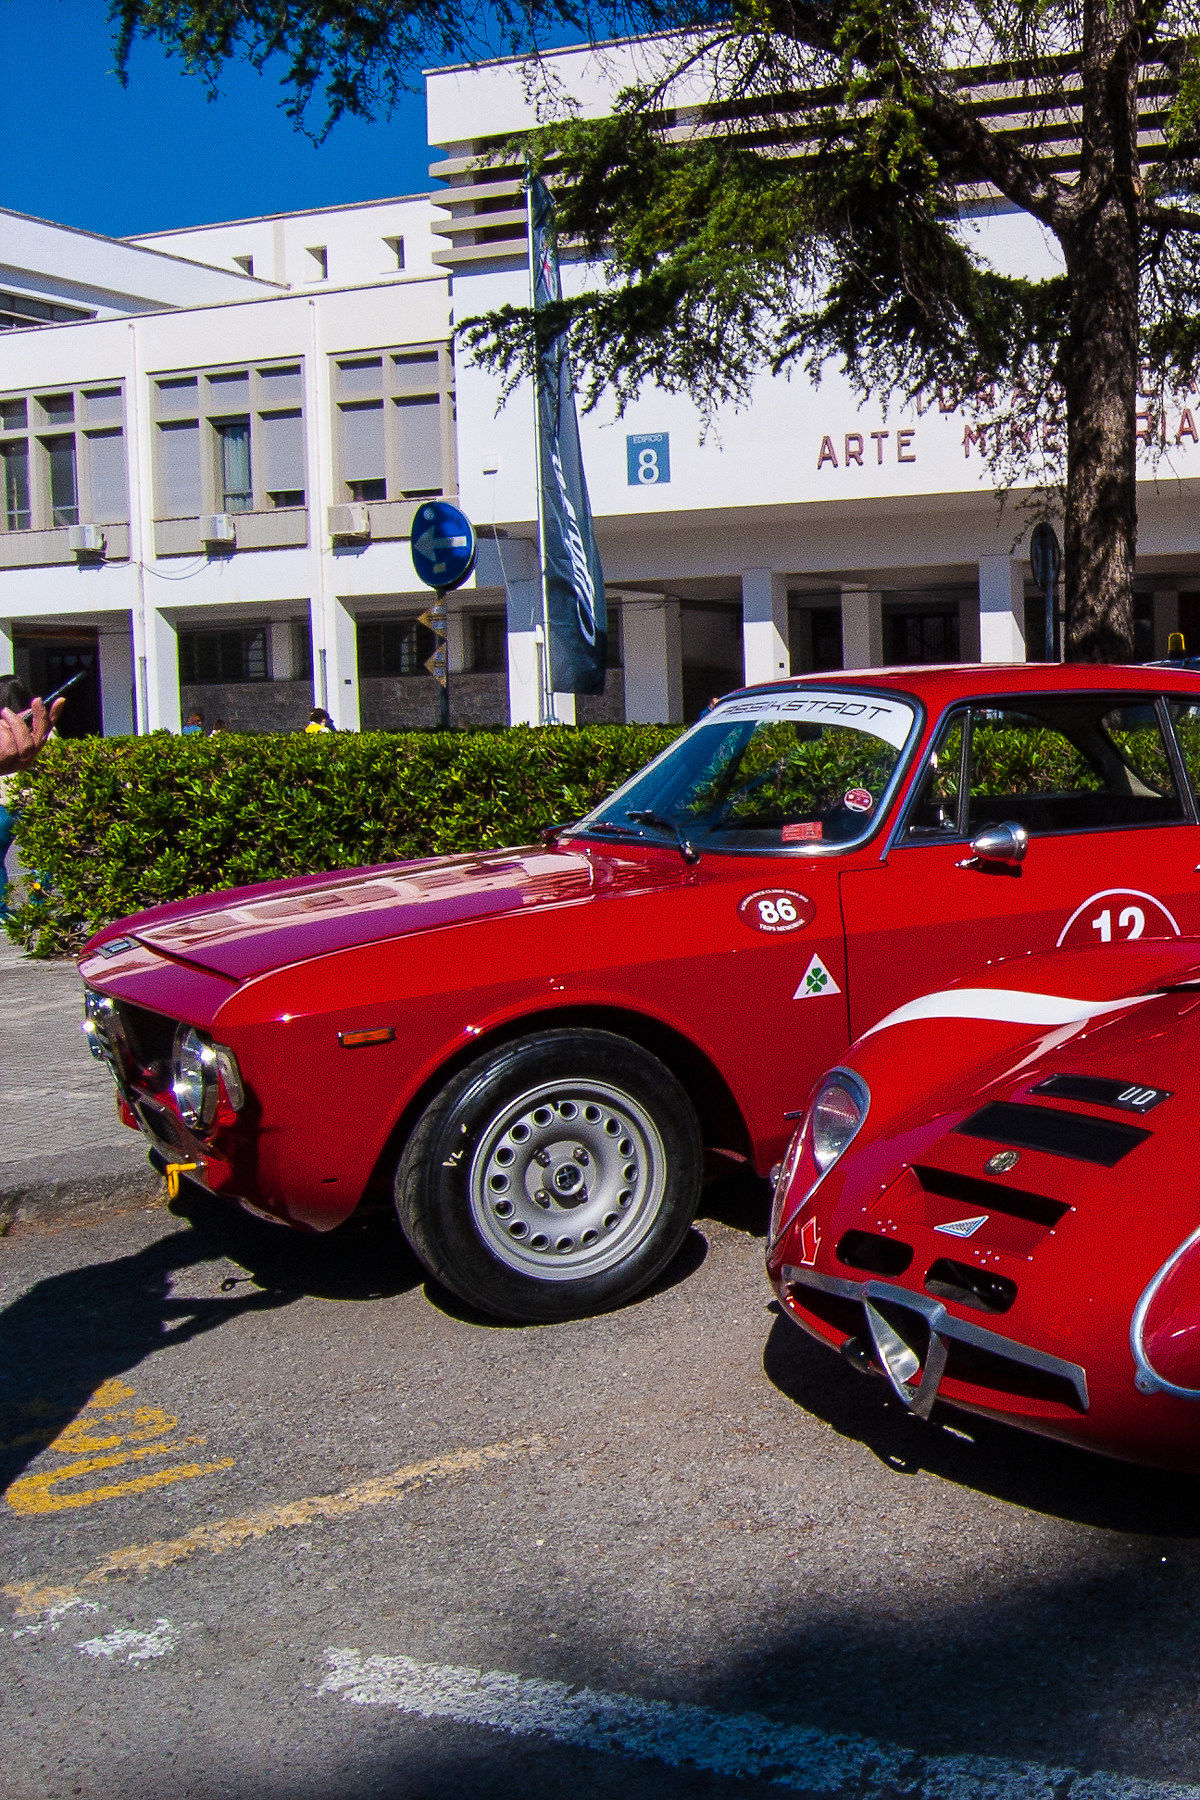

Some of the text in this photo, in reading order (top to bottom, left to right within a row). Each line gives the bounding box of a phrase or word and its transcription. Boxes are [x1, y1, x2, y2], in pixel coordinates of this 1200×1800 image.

[637, 448, 659, 484] 8
[817, 428, 917, 470] ARTE
[758, 897, 797, 924] 86
[1092, 906, 1146, 943] 12
